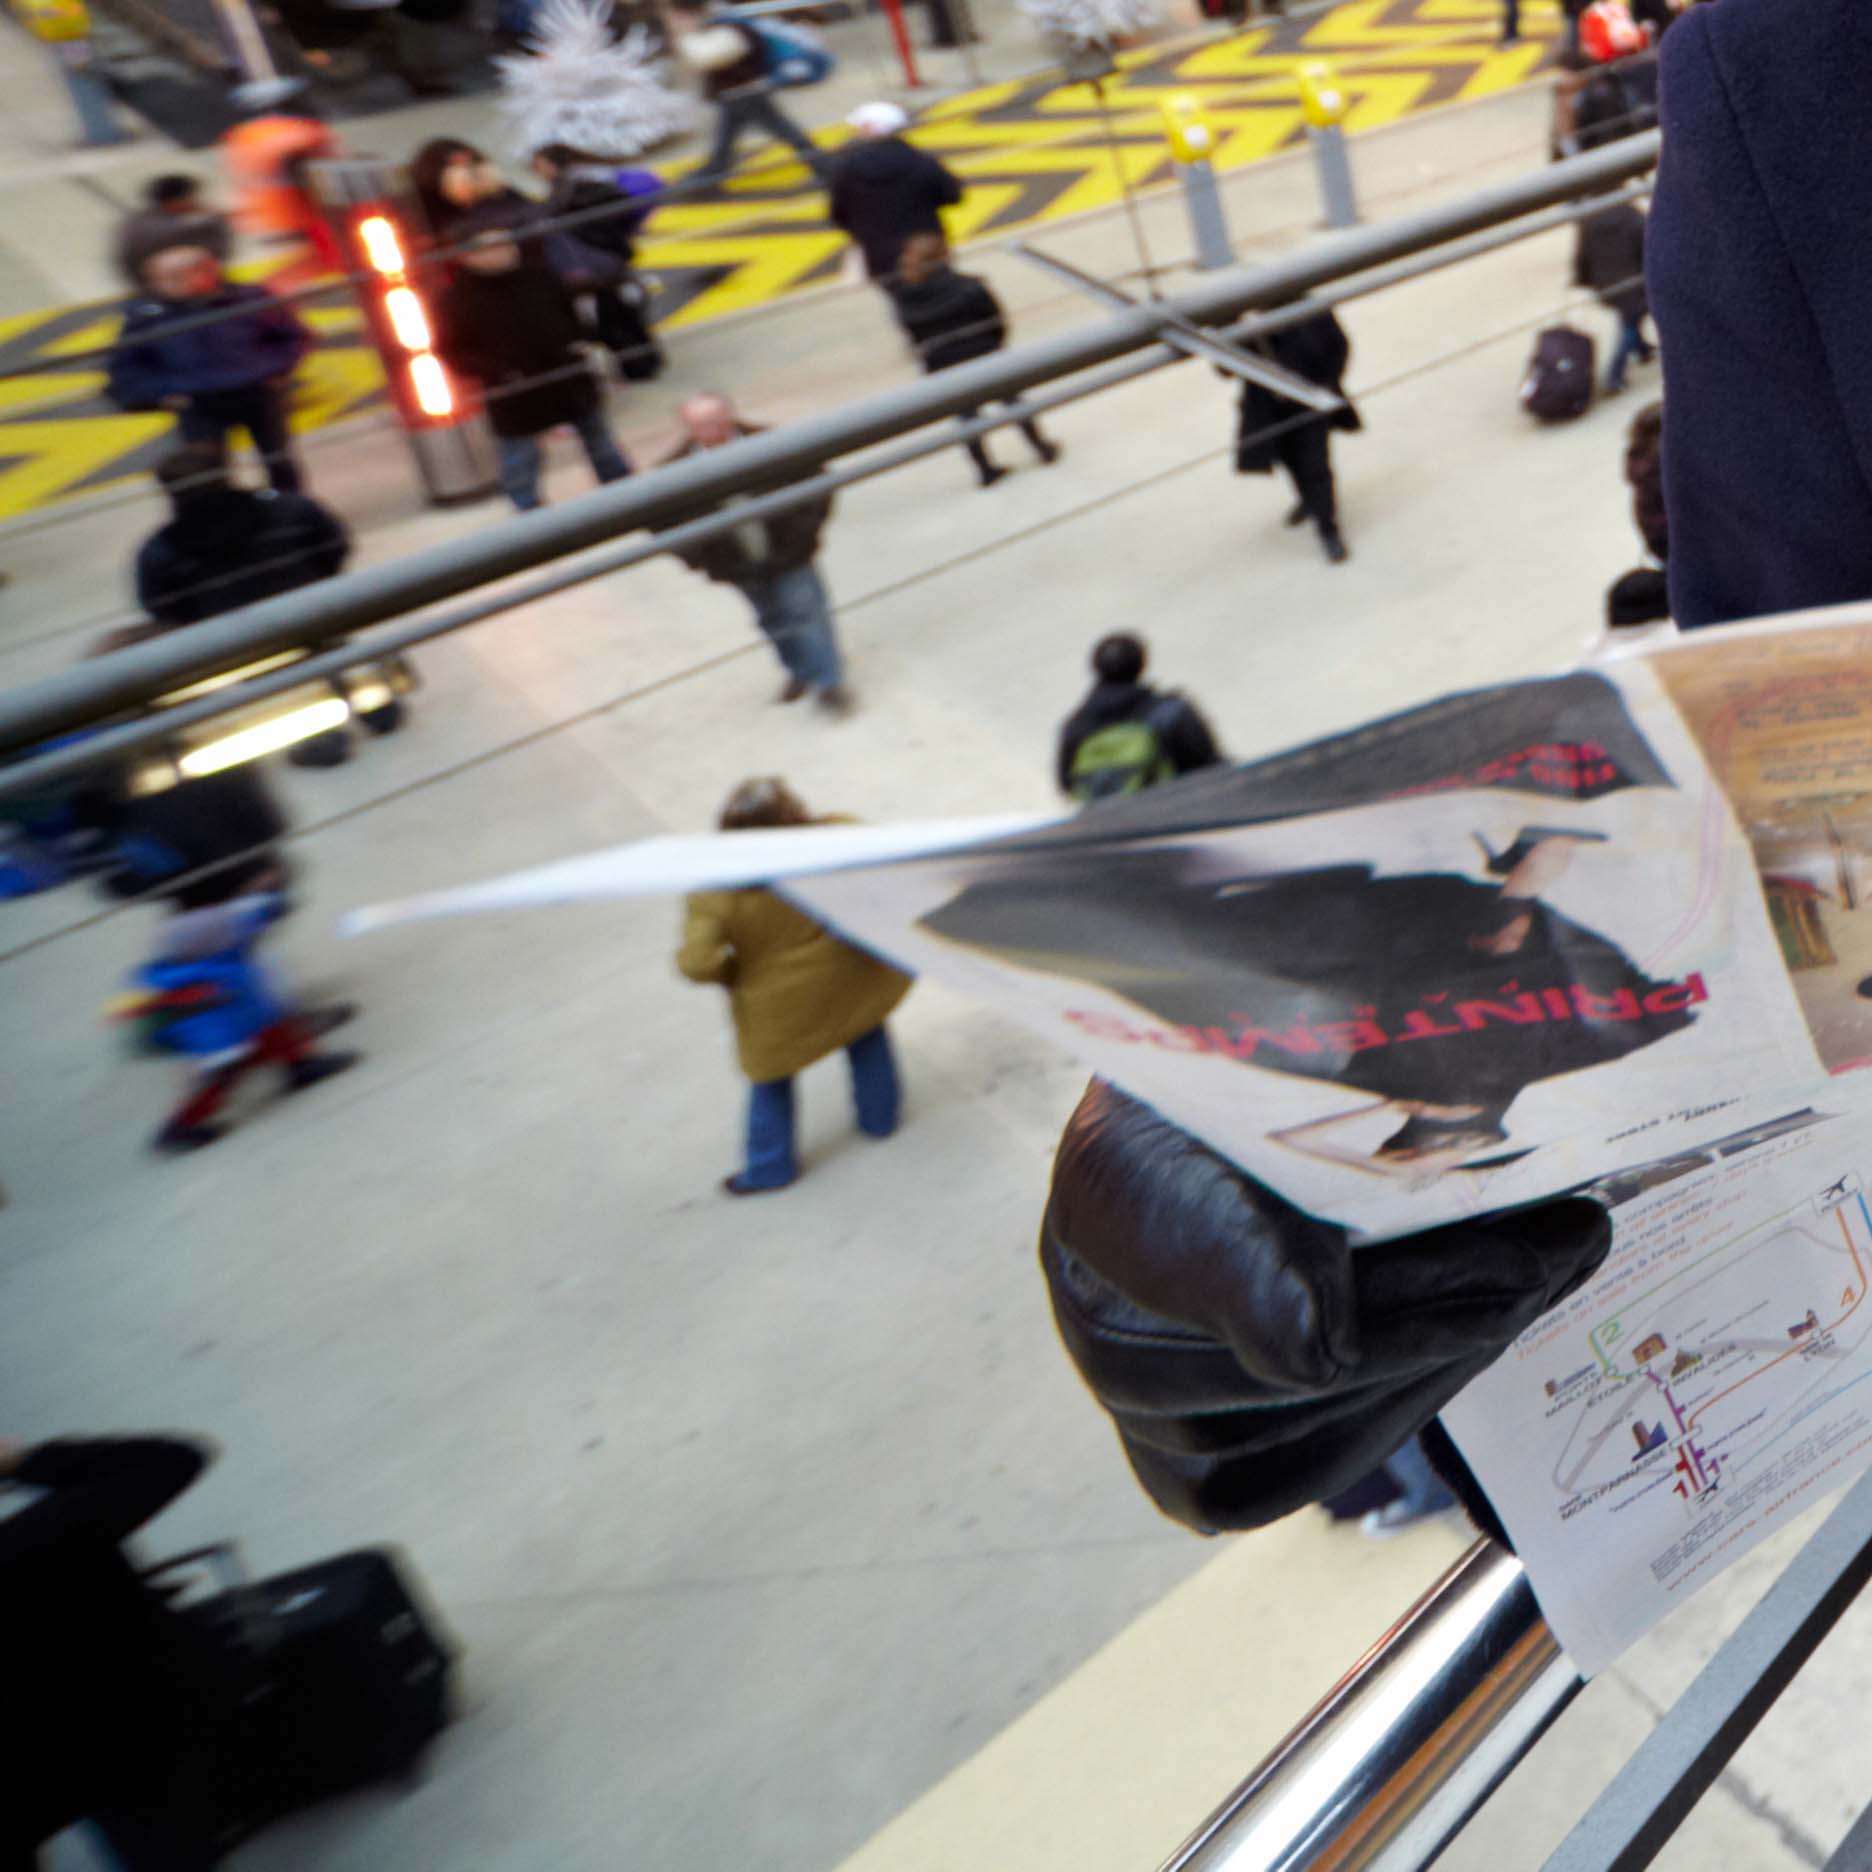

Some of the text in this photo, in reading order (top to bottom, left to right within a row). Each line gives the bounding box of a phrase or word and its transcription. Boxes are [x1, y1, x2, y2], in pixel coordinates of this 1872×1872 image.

[1060, 971, 1711, 1063] PRINTEMPS
[1600, 1320, 1625, 1346] 2
[1560, 1445, 1668, 1521] MONTPARNASSE
[1673, 1479, 1690, 1499] 1
